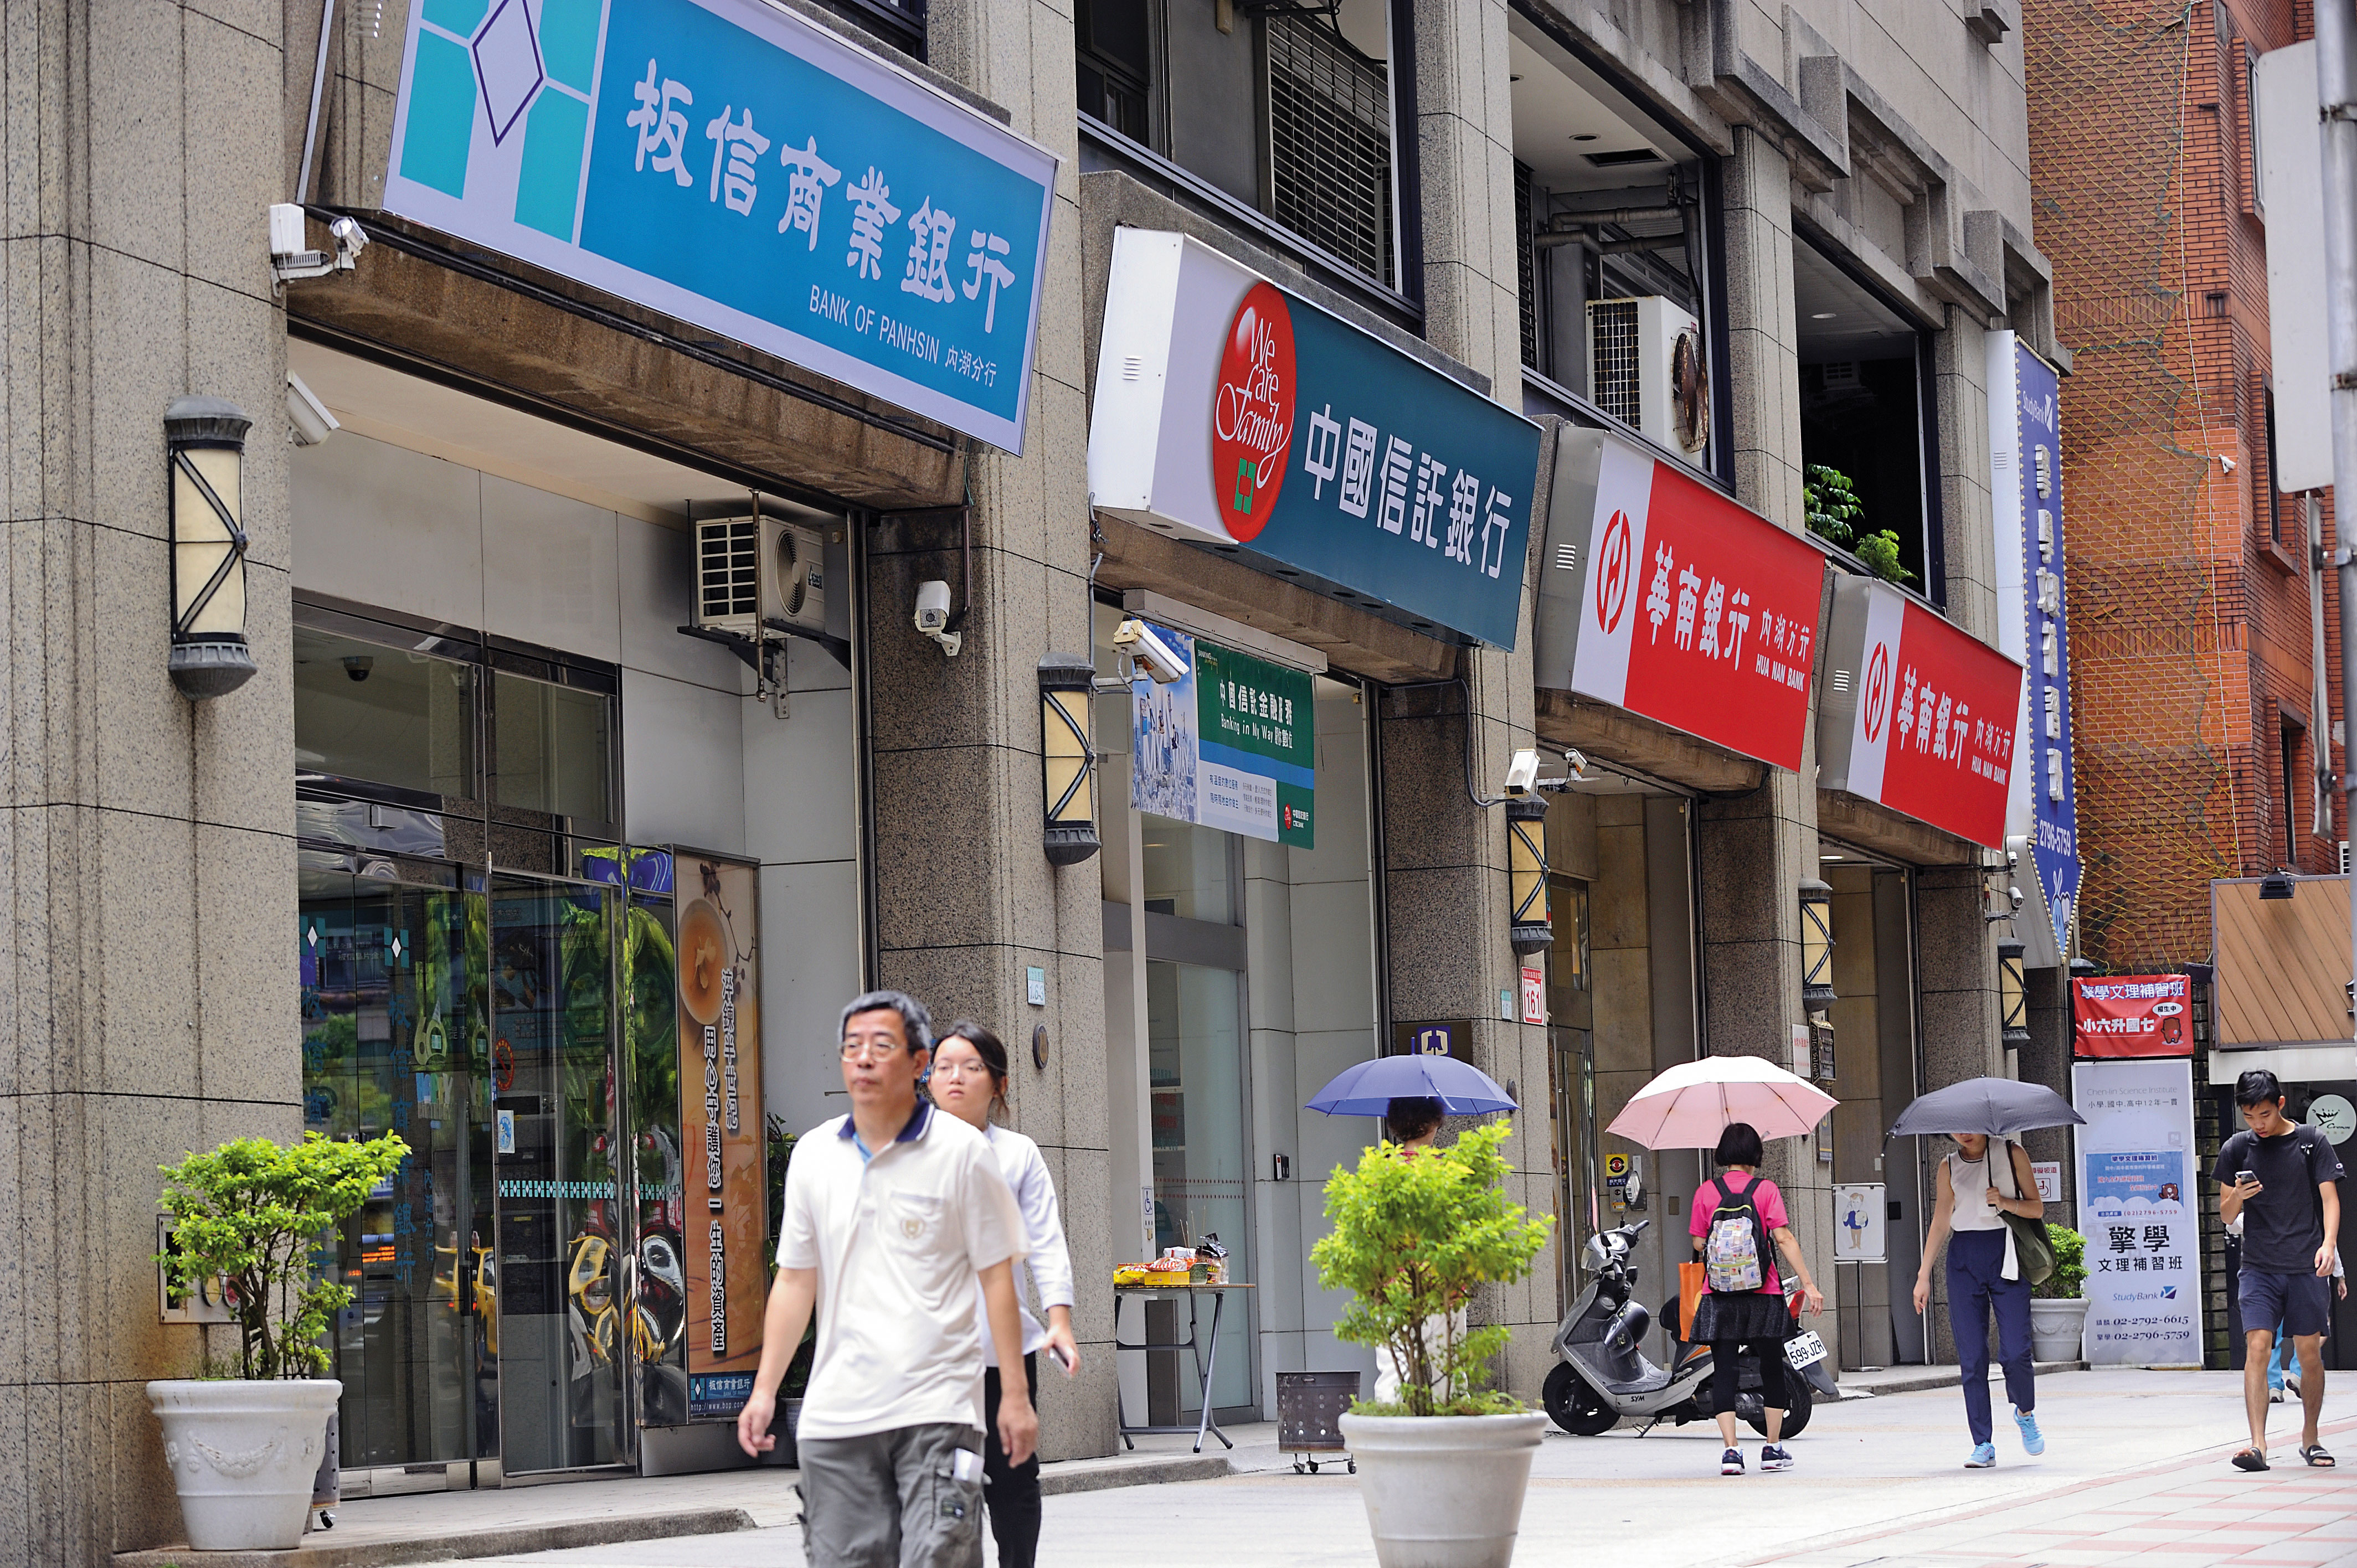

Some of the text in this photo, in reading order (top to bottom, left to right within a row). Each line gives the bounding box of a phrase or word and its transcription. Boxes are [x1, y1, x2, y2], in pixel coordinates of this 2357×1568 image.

[626, 58, 1016, 333] 板信商業銀行
[809, 284, 996, 388] BANK OF PANHSIN 內湖分行
[1250, 313, 1275, 372] We
[1304, 403, 1512, 579] 中國信託銀行
[1646, 540, 1750, 672] 華南銀行
[1759, 608, 1810, 662] 內湖分行
[1756, 653, 1805, 692] HUA NAN BANK
[1221, 713, 1240, 735] Banking
[1243, 720, 1249, 735] in
[1262, 724, 1273, 744] Way
[1897, 664, 1969, 770] 華南銀行
[1974, 716, 2011, 761] 內湖分行
[1971, 755, 2006, 786] HUA NAN BANK
[2039, 819, 2071, 857] 2796-5759
[1526, 989, 1540, 1015] 161
[2081, 981, 2185, 1001] 擎學文理補習班
[2109, 1225, 2170, 1254] 擎學
[2098, 1256, 2183, 1272] 文理補習班
[2113, 1292, 2158, 1302] StudyBank
[2113, 1314, 2189, 1327] 02-2792-6615
[2114, 1330, 2190, 1342] 02-2796-5759
